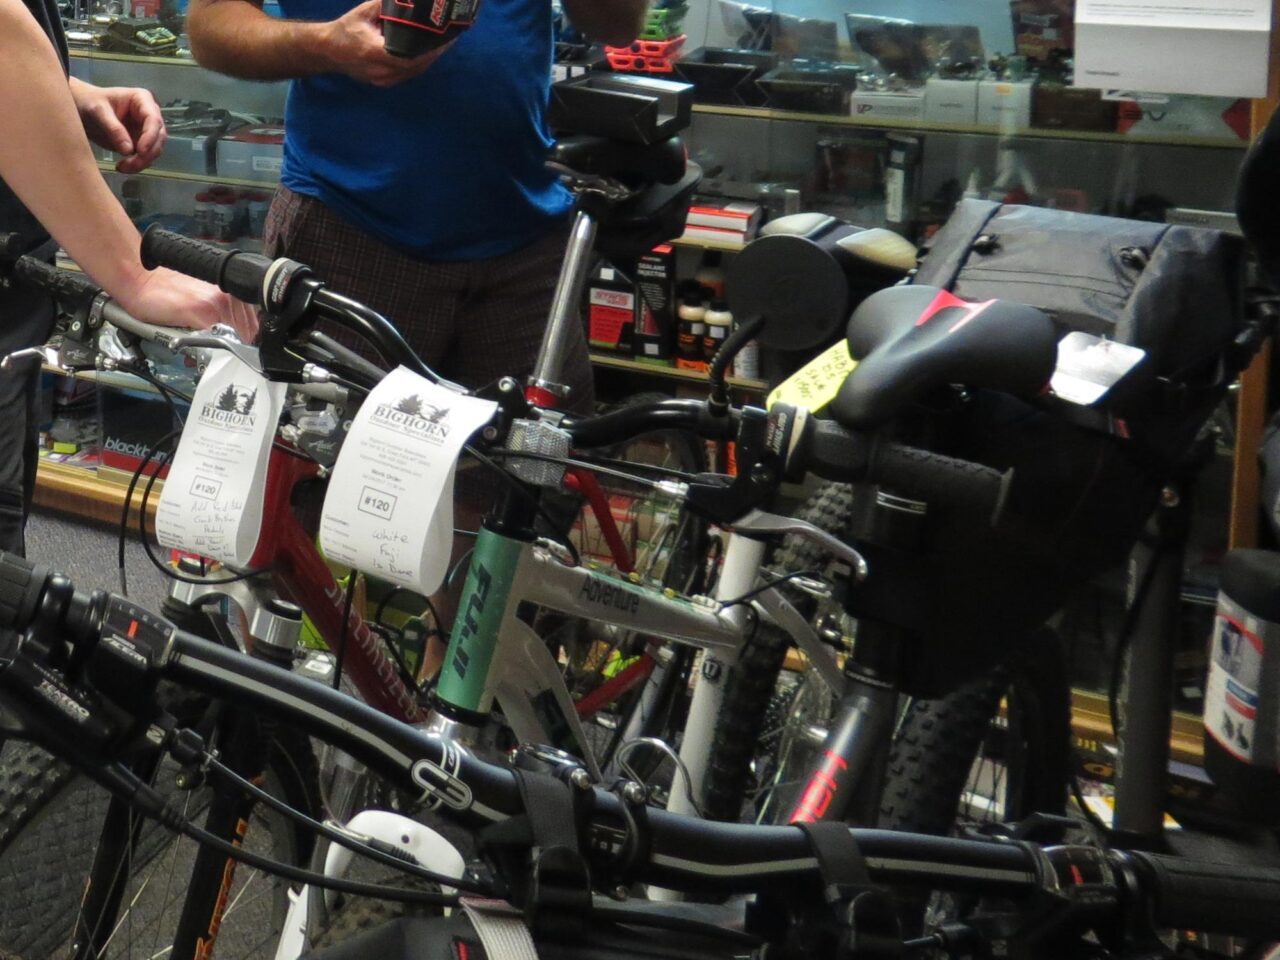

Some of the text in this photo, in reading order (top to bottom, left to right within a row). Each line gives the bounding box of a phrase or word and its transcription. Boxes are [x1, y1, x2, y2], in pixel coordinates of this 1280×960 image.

[200, 406, 256, 427] BIGHORN
[374, 406, 450, 438] BIGHORN
[195, 484, 216, 495] #120
[364, 496, 390, 512] #120
[578, 574, 640, 614] Adventure
